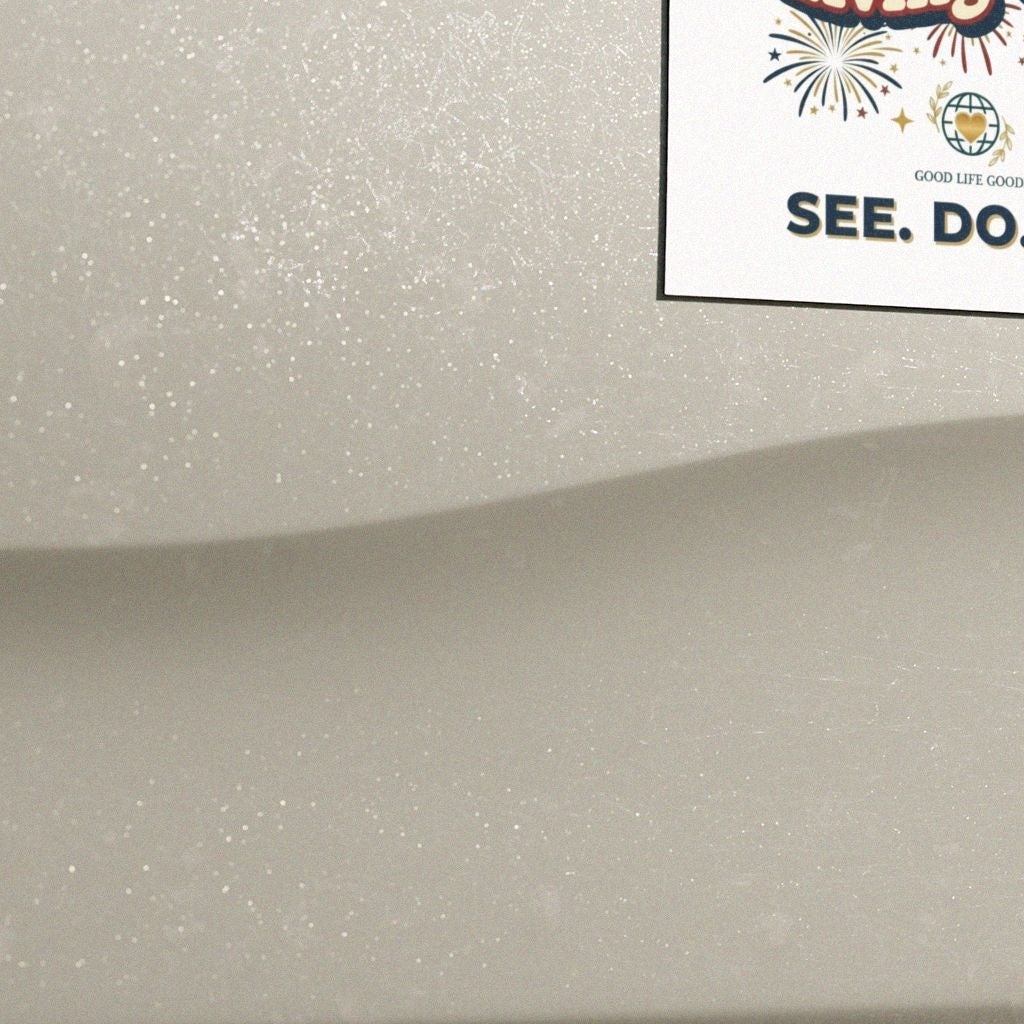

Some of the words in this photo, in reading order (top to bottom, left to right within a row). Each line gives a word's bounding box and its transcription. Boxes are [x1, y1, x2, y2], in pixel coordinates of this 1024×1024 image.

[914, 169, 953, 183] GOOD
[956, 172, 983, 186] LIFE
[786, 191, 913, 242] SEE.
